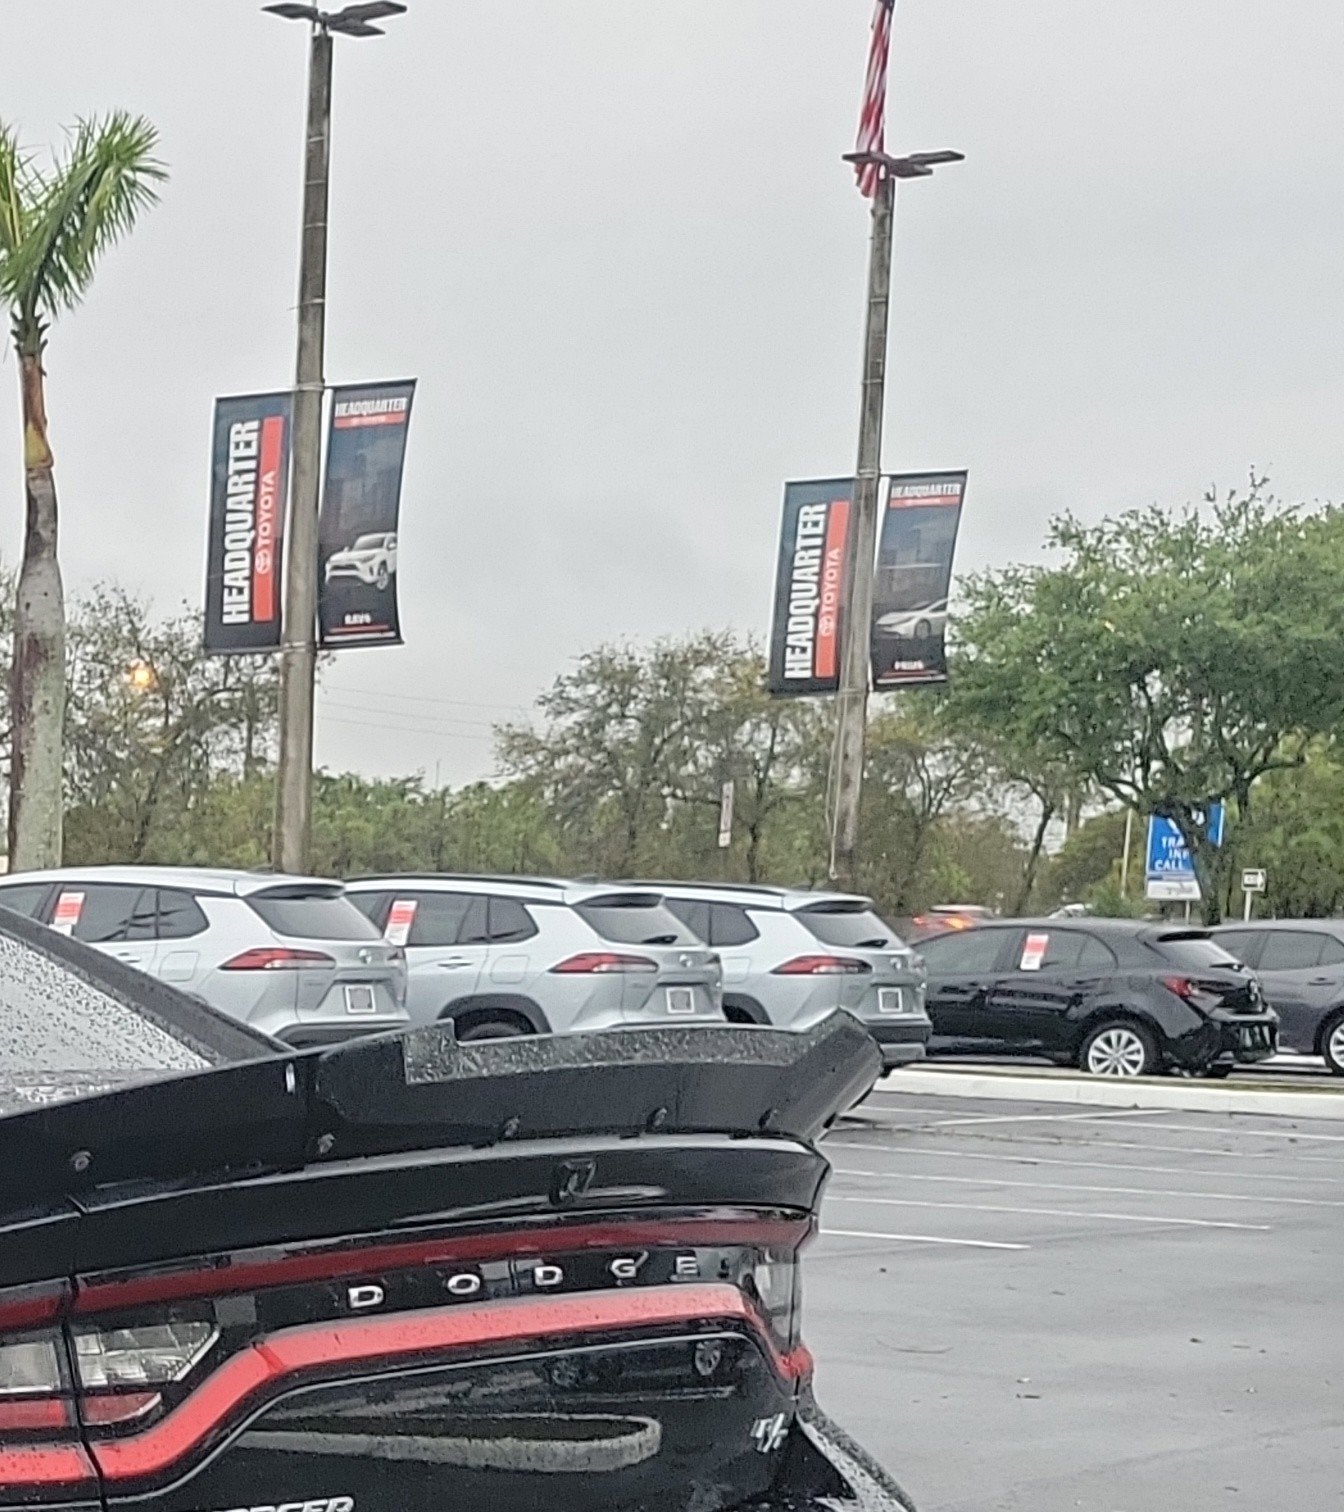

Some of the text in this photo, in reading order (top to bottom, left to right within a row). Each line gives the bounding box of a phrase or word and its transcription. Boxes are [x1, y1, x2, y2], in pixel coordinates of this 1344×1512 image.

[222, 420, 260, 624] HEADQUARTER
[258, 470, 277, 547] TOYOTA
[784, 503, 827, 679] HEADQUARTER
[823, 548, 843, 616] TOYOTA
[1155, 860, 1183, 871] CALL
[347, 1254, 700, 1309] DODGE
